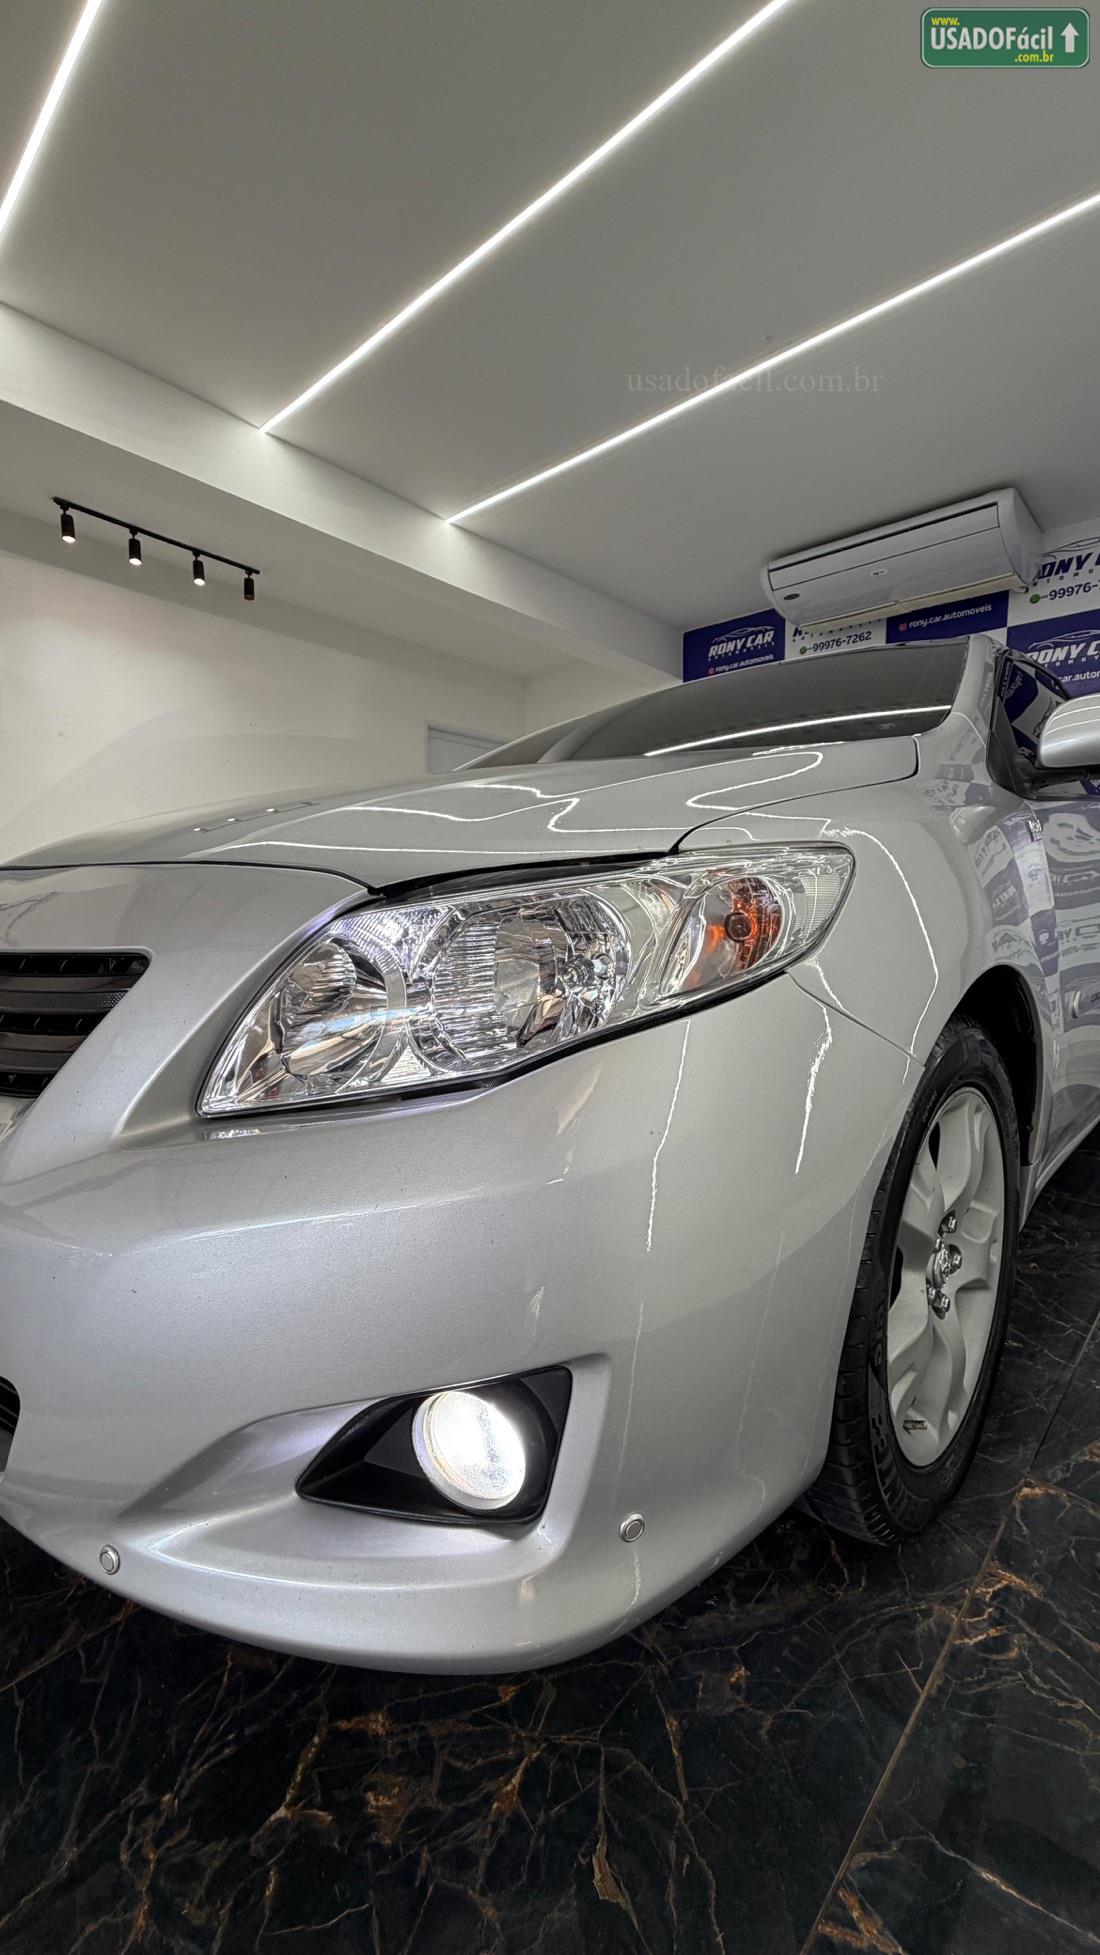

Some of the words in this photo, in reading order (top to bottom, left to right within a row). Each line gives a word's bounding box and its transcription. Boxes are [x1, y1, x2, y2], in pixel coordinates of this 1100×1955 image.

[1037, 552, 1094, 580] ONY
[1048, 581, 1100, 601] 99976-
[909, 603, 992, 629] rony.car.automoveis
[708, 637, 745, 658] RONY
[746, 630, 775, 648] CAR
